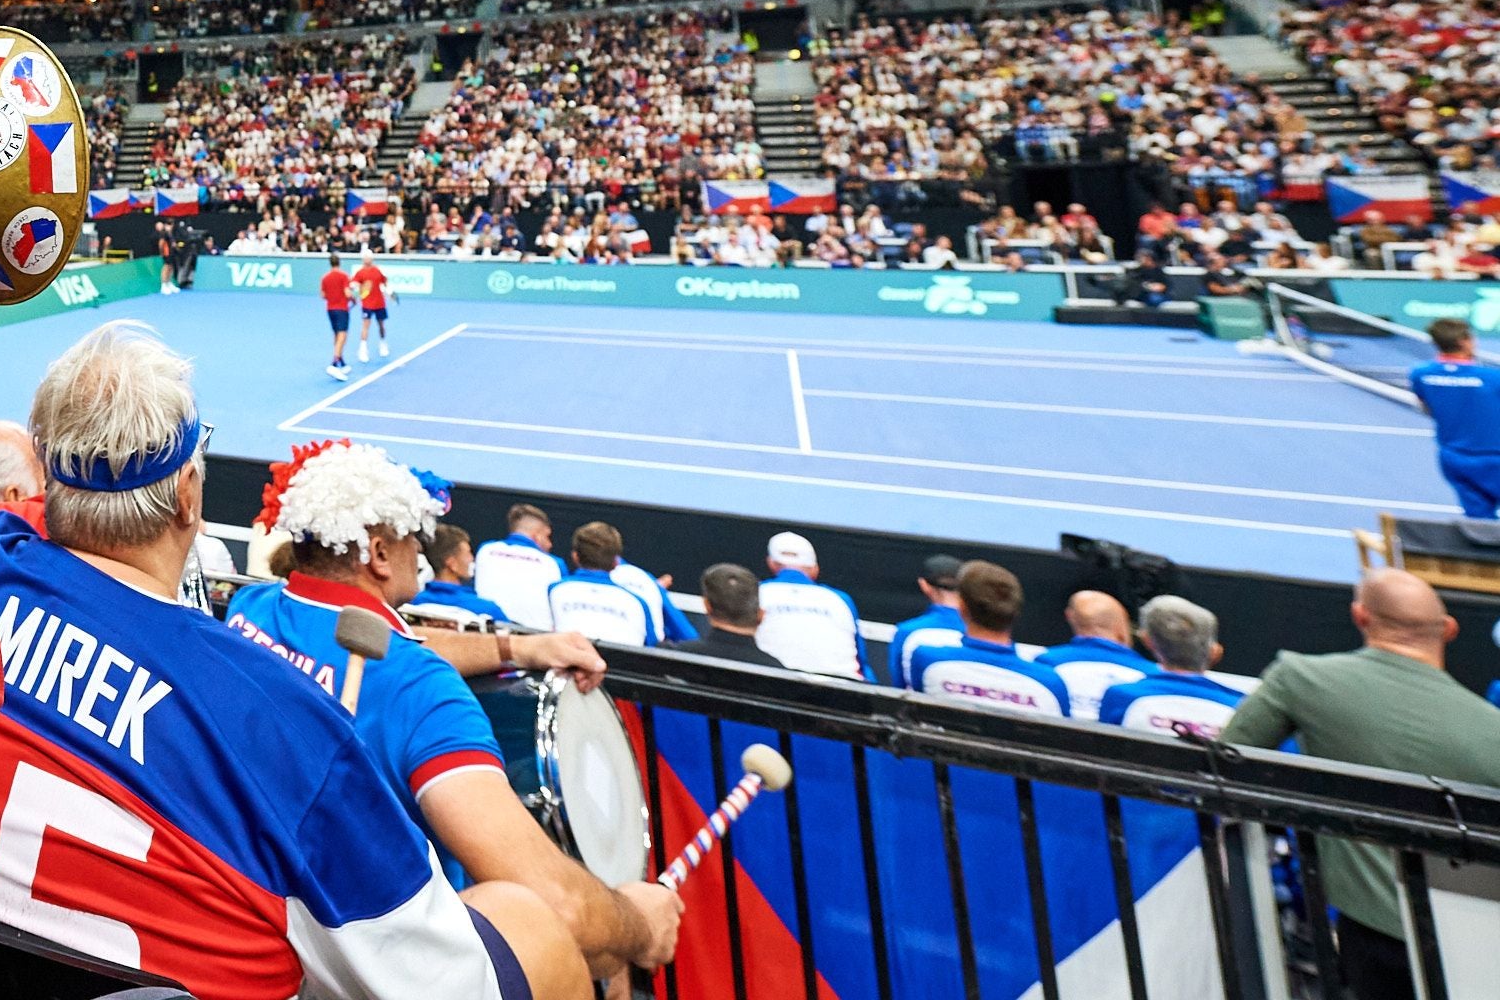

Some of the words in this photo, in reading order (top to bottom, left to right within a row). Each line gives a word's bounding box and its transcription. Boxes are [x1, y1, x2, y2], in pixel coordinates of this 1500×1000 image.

[226, 261, 293, 288] VISA
[51, 273, 100, 306] VISA
[941, 680, 1040, 708] CZECHIA
